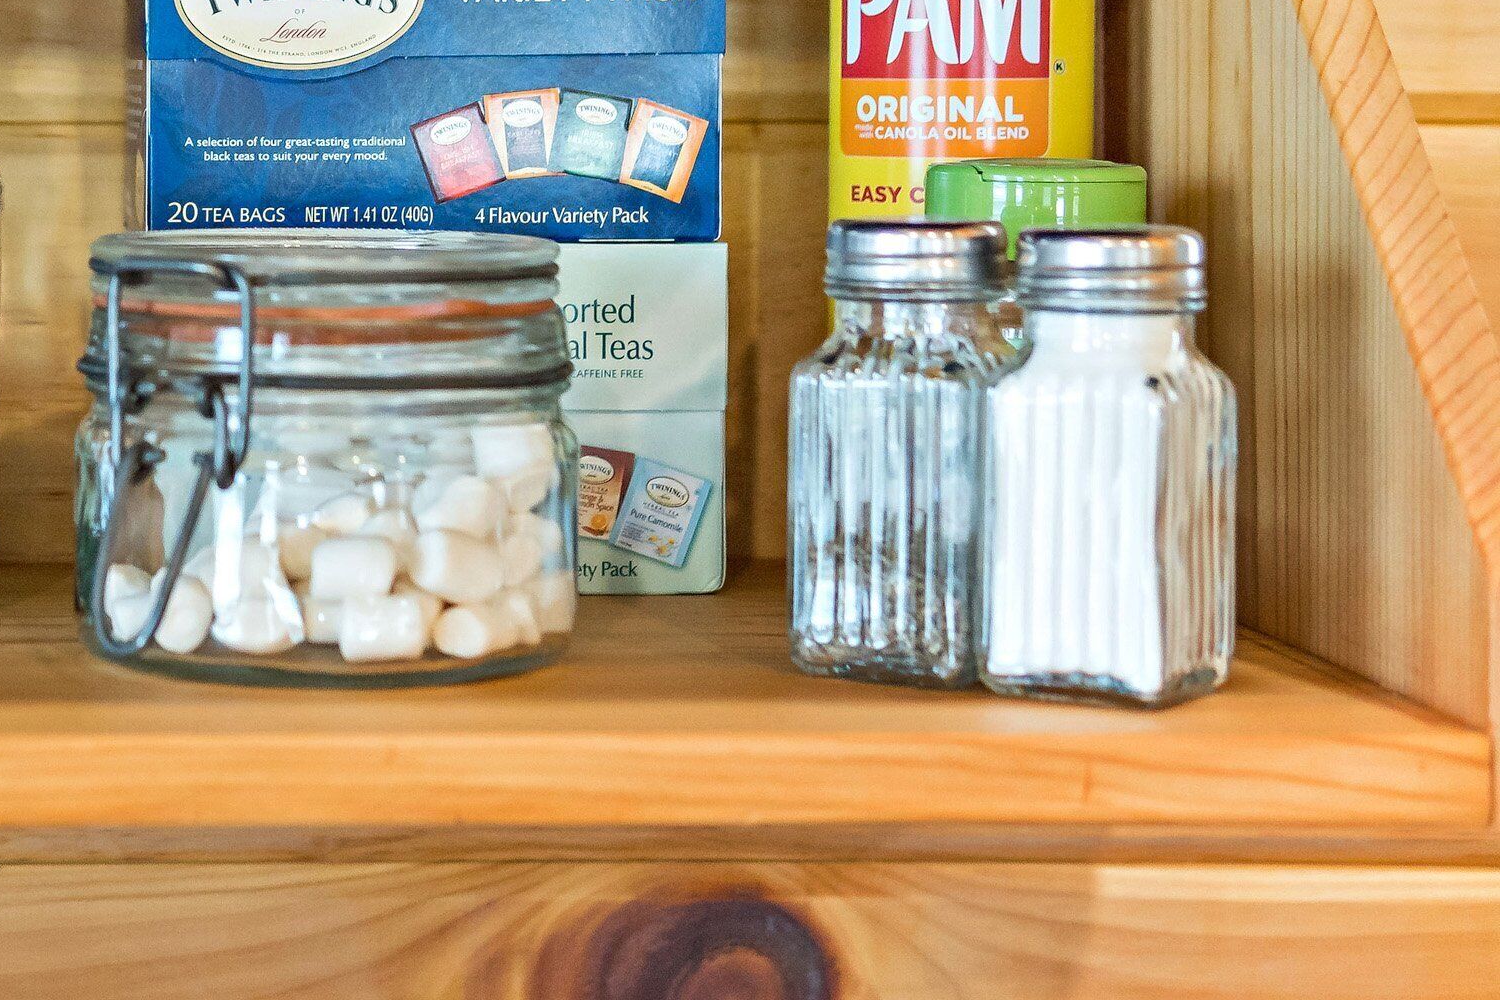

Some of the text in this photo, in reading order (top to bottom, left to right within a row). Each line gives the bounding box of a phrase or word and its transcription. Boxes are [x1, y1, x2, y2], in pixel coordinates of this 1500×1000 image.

[259, 18, 327, 44] London
[856, 95, 1024, 123] ORIGINAL
[184, 136, 406, 150] A selection of four great-tasting traditional
[874, 126, 1029, 140] CANOLA OIL BLEND
[204, 151, 388, 163] black teas to suit your every mood.
[851, 185, 901, 203] EASY
[168, 202, 286, 223] 20 TEA BAGS
[305, 206, 434, 225] NET WT 1.41 OZ (40G)
[474, 206, 650, 228] 4 Flavour Variety Pack
[562, 294, 635, 324] orted
[595, 332, 654, 360] Teas
[572, 369, 644, 379] AFFEINE FREE
[630, 507, 647, 521] Pure
[647, 514, 683, 533] Camomile
[601, 560, 638, 577] Pack
